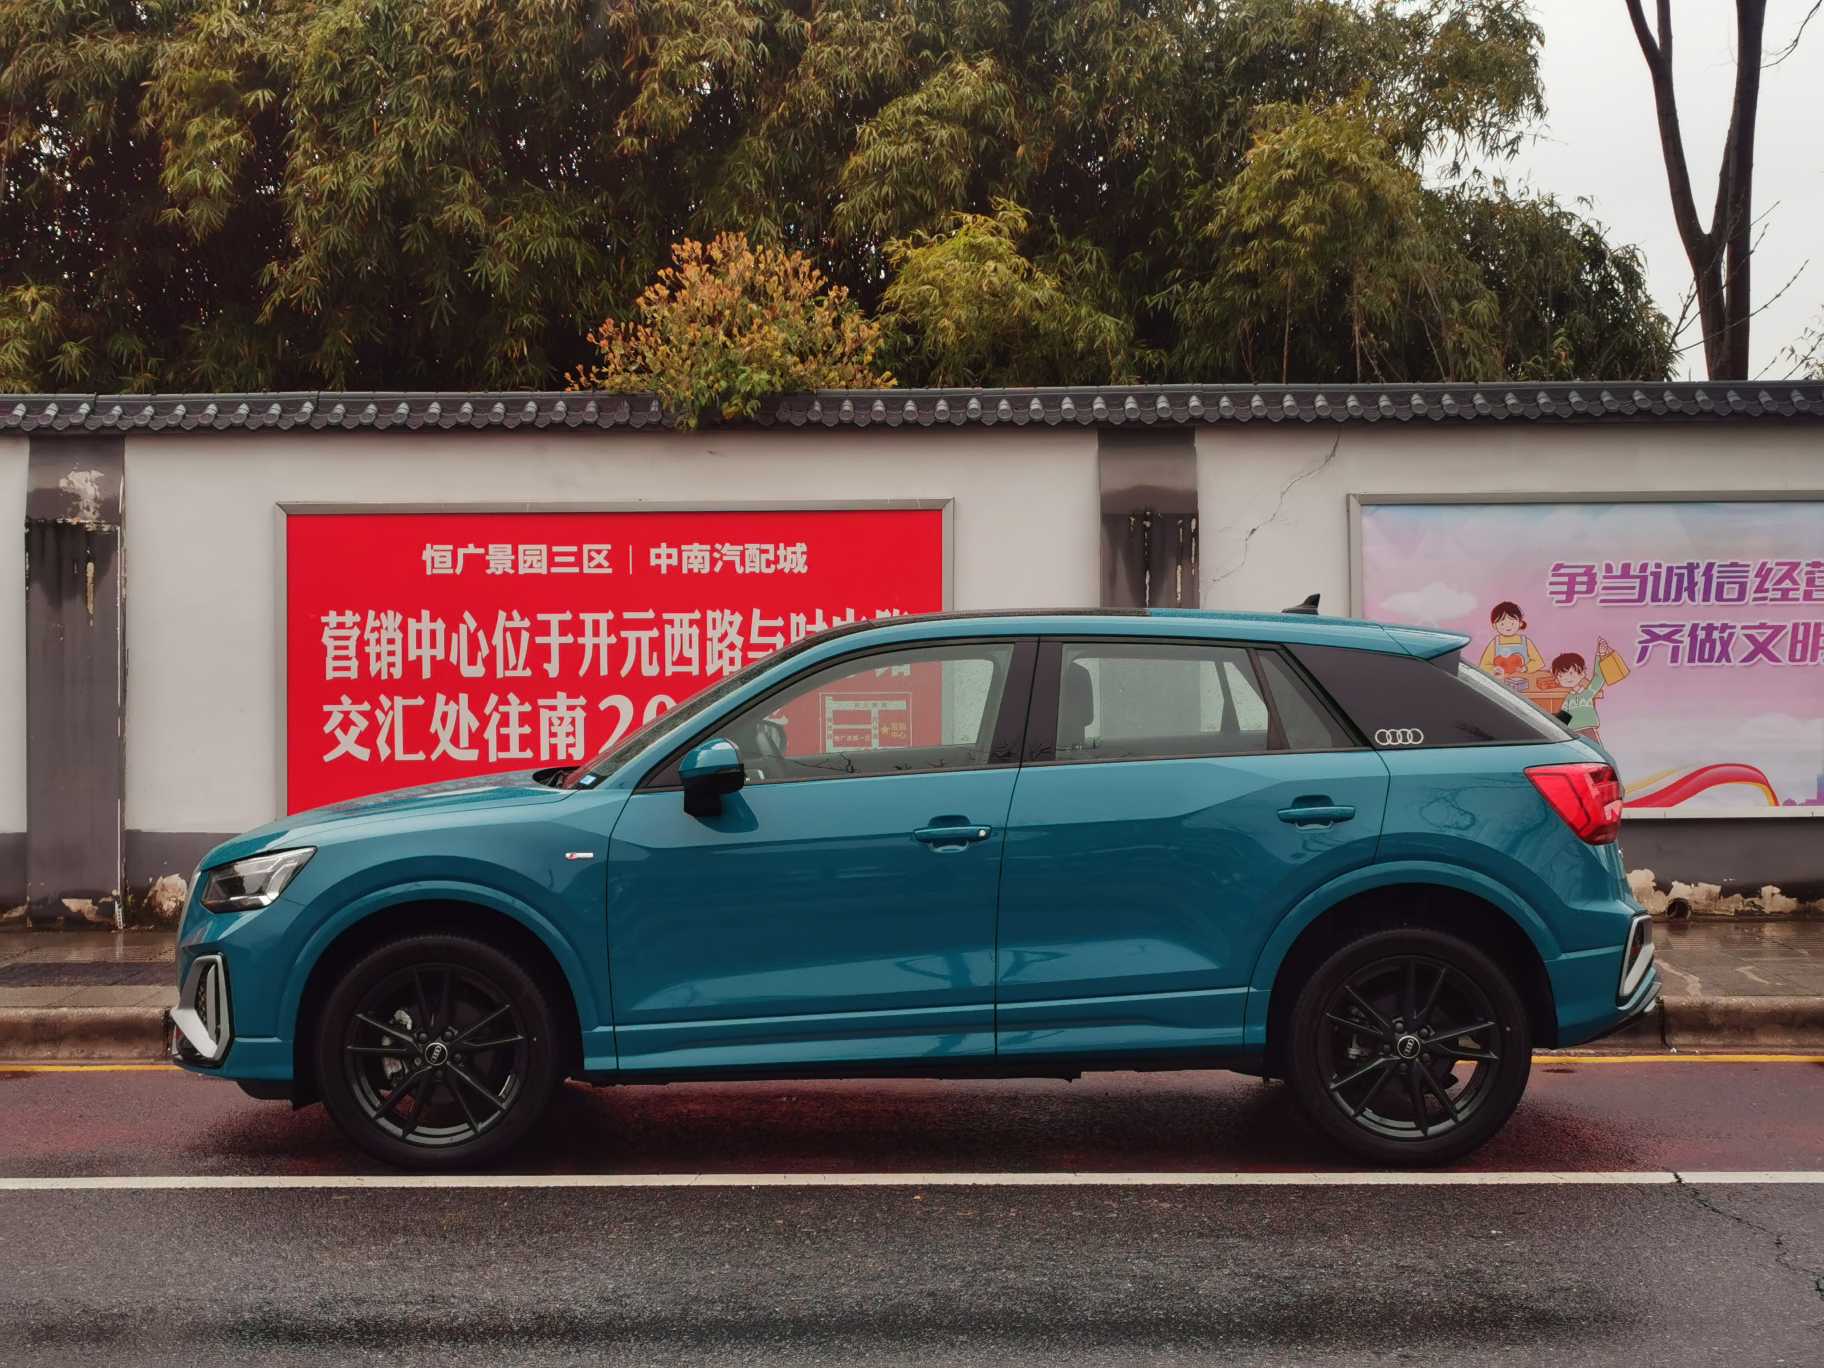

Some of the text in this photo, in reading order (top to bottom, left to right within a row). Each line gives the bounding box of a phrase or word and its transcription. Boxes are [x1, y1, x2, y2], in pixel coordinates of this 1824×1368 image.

[422, 543, 808, 575] 恒广景园三区 中南汽配城
